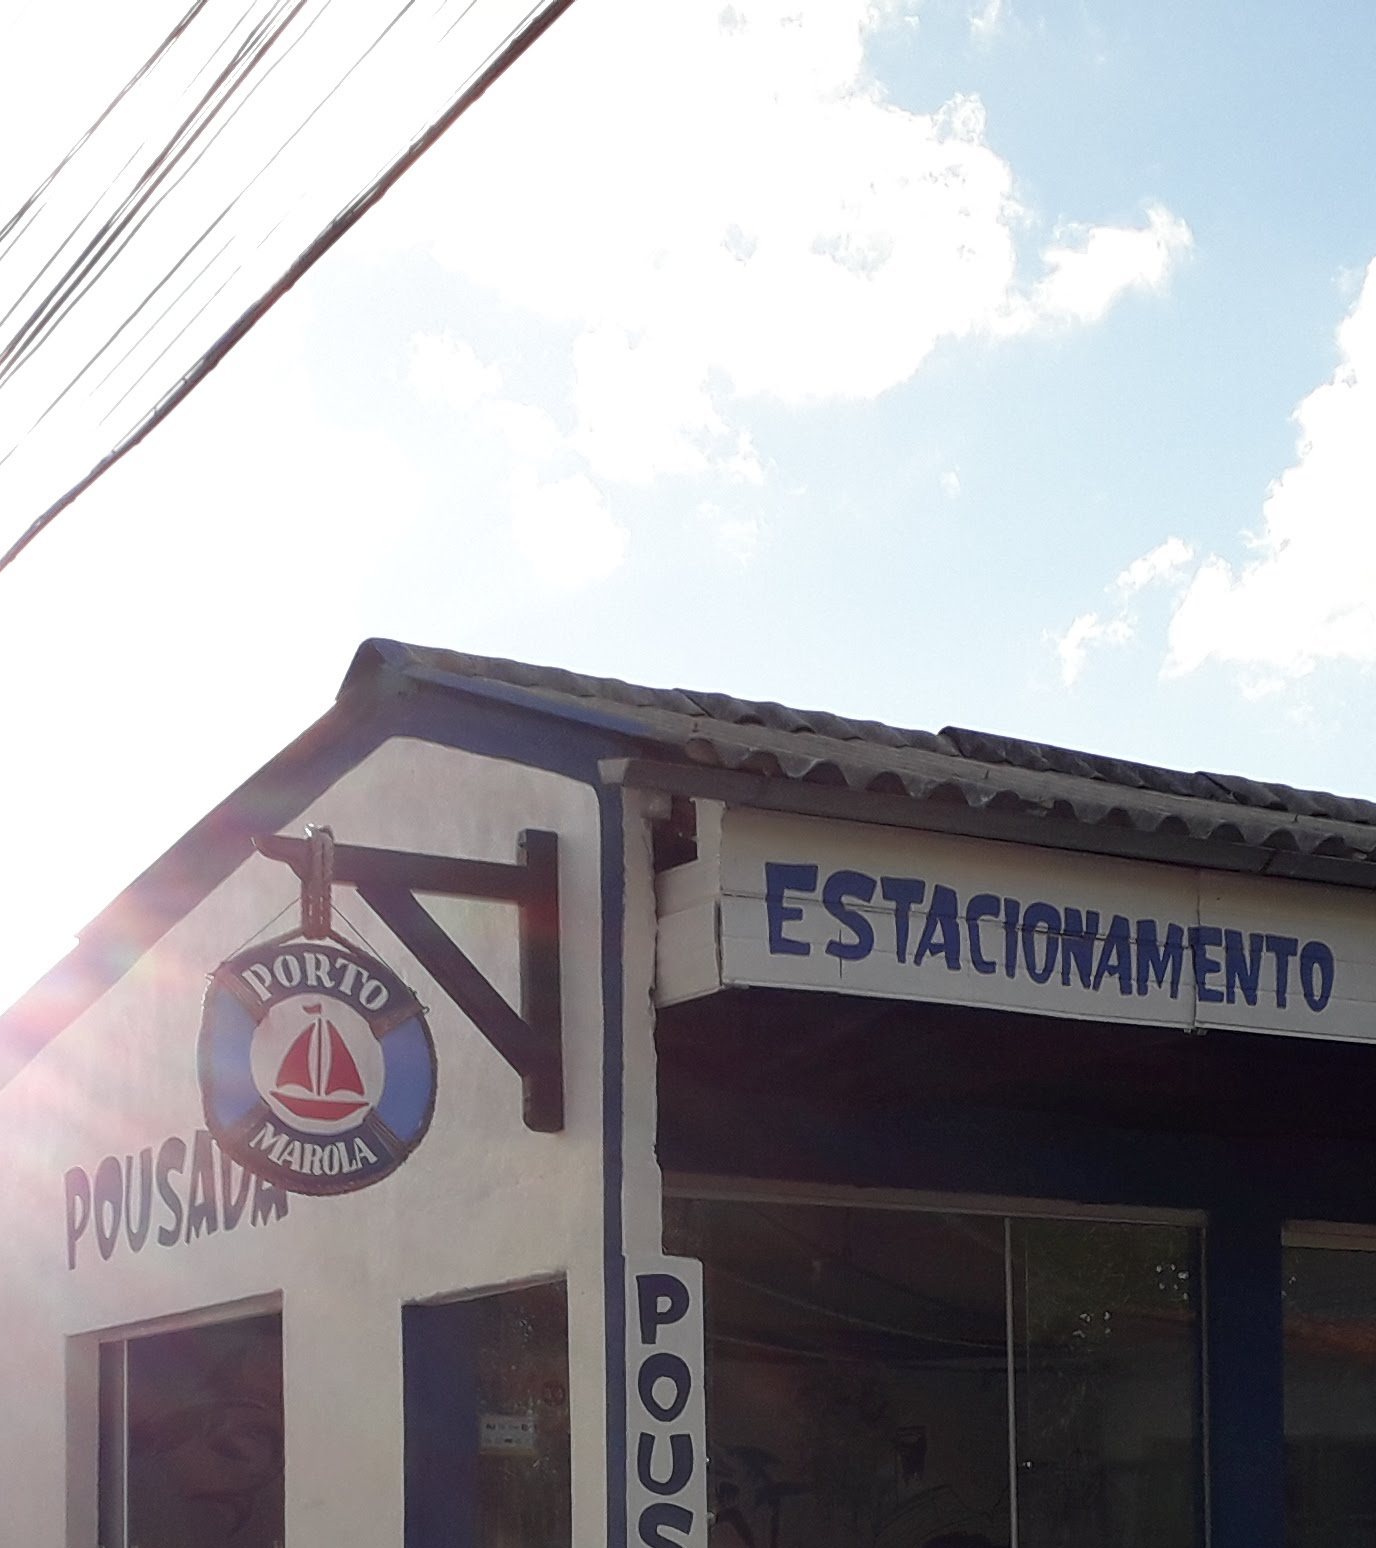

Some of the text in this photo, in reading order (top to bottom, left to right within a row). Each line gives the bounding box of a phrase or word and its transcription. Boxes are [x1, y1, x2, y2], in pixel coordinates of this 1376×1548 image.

[764, 861, 1335, 1013] ESTACIONAMENTO
[241, 951, 389, 1012] PORTO
[248, 1121, 377, 1176] MAROLA
